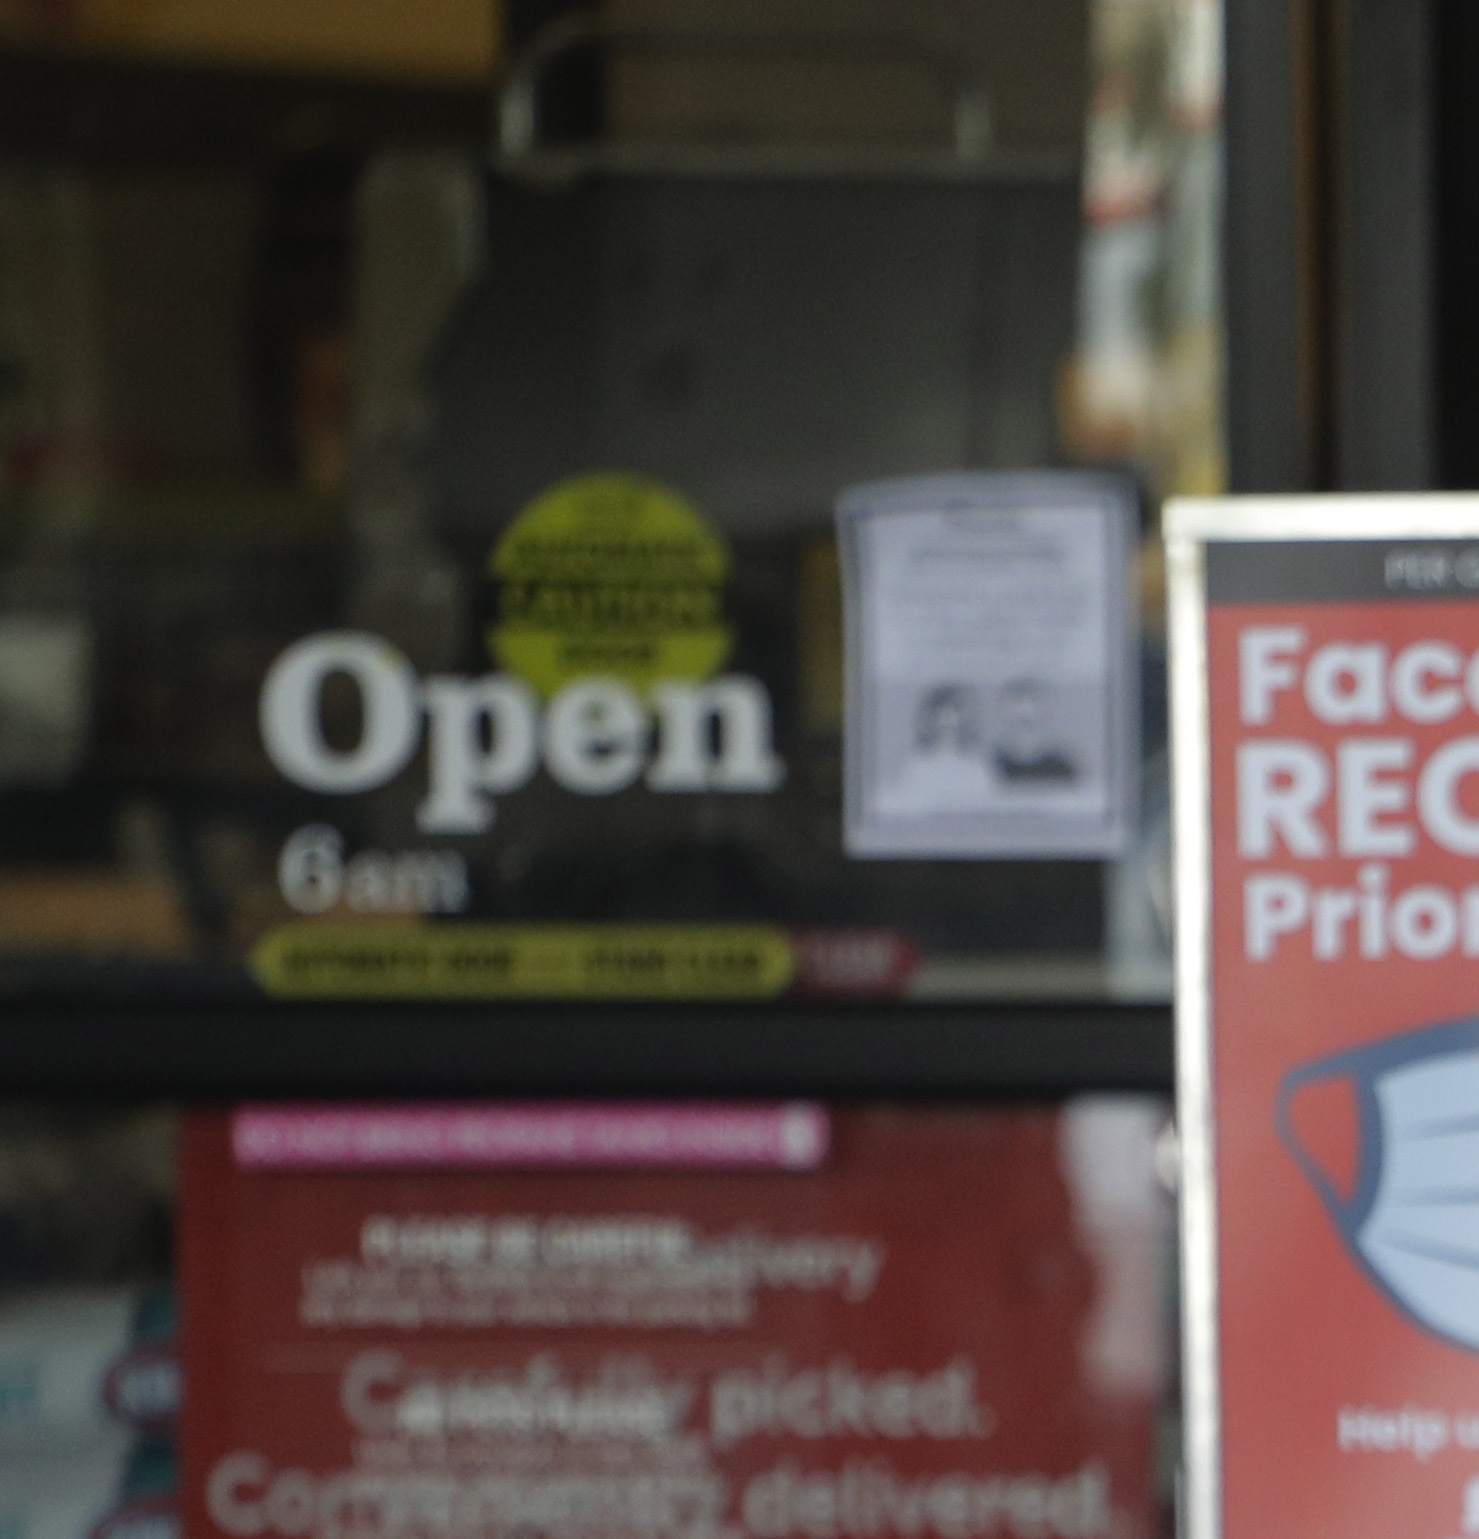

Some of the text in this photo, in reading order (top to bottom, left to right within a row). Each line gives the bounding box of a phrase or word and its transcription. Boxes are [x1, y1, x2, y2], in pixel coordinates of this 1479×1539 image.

[1384, 548, 1446, 589] PER
[260, 632, 786, 834] Open
[279, 826, 470, 914] 6am
[713, 1354, 992, 1446] picked.
[1338, 1405, 1448, 1464] Help
